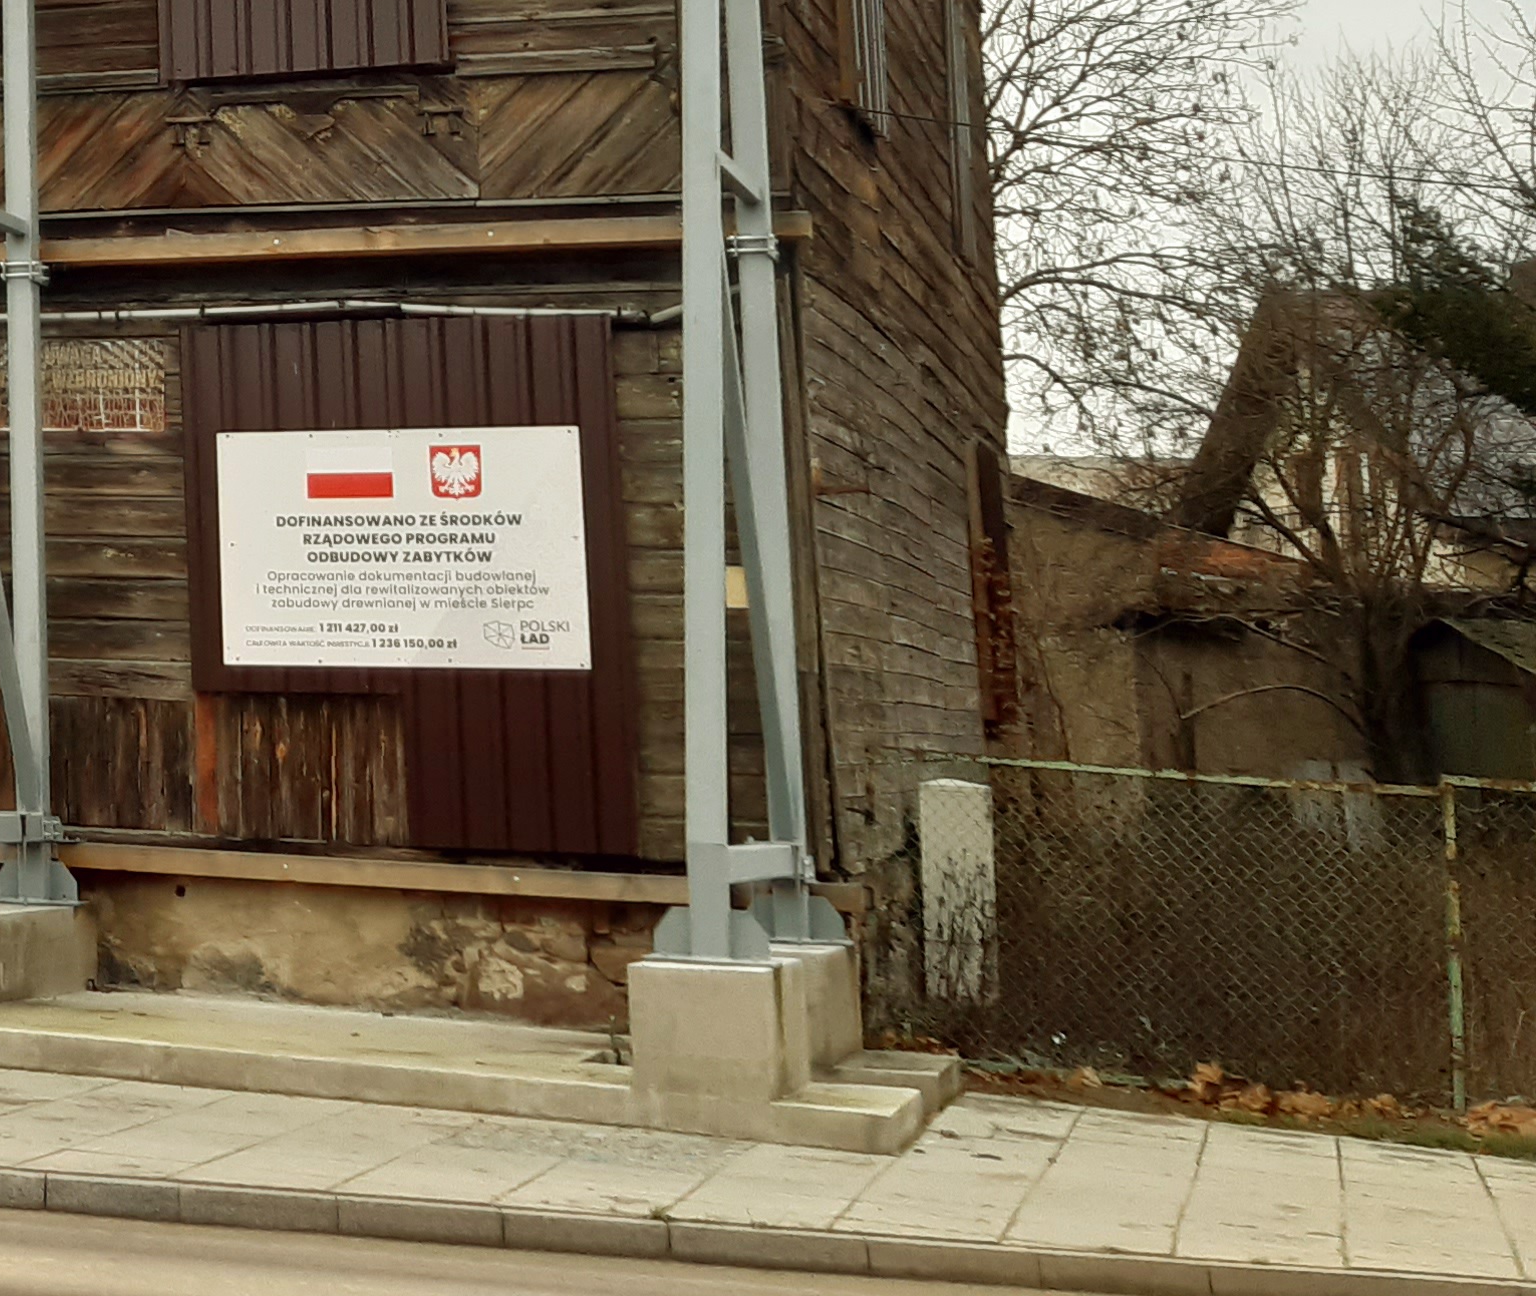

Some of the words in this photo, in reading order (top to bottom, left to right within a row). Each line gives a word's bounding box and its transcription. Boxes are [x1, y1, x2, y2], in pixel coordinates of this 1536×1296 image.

[276, 515, 416, 527] DOFINANSOWANO
[419, 515, 437, 526] ZE
[440, 511, 522, 526] ŚRODKÓW
[303, 533, 403, 547] RZĄDOWEGO
[406, 533, 496, 544] PROGRAMU
[307, 551, 398, 563] ODBUDOWY
[402, 548, 493, 563] ZABYTKÓW
[267, 571, 355, 584] Opracowanie
[358, 570, 453, 584] dokumentacji
[456, 570, 537, 584] budowlanej
[263, 584, 338, 597] technicznej
[341, 584, 362, 595] dla
[365, 584, 483, 598] rewitalizowanych
[486, 583, 550, 596] obiektów
[271, 598, 338, 611] zabudowy
[341, 598, 417, 611] drewnianej
[419, 600, 430, 609] w
[434, 597, 487, 609] mieście
[490, 597, 535, 612] Sierpc
[326, 623, 342, 632] 211
[344, 623, 386, 634] 427,00
[388, 622, 399, 633] zł
[520, 620, 570, 632] POLSKI
[378, 638, 401, 648] 236
[403, 638, 445, 650] 150,00
[447, 638, 458, 649] zł
[520, 633, 550, 644] ŁAD
